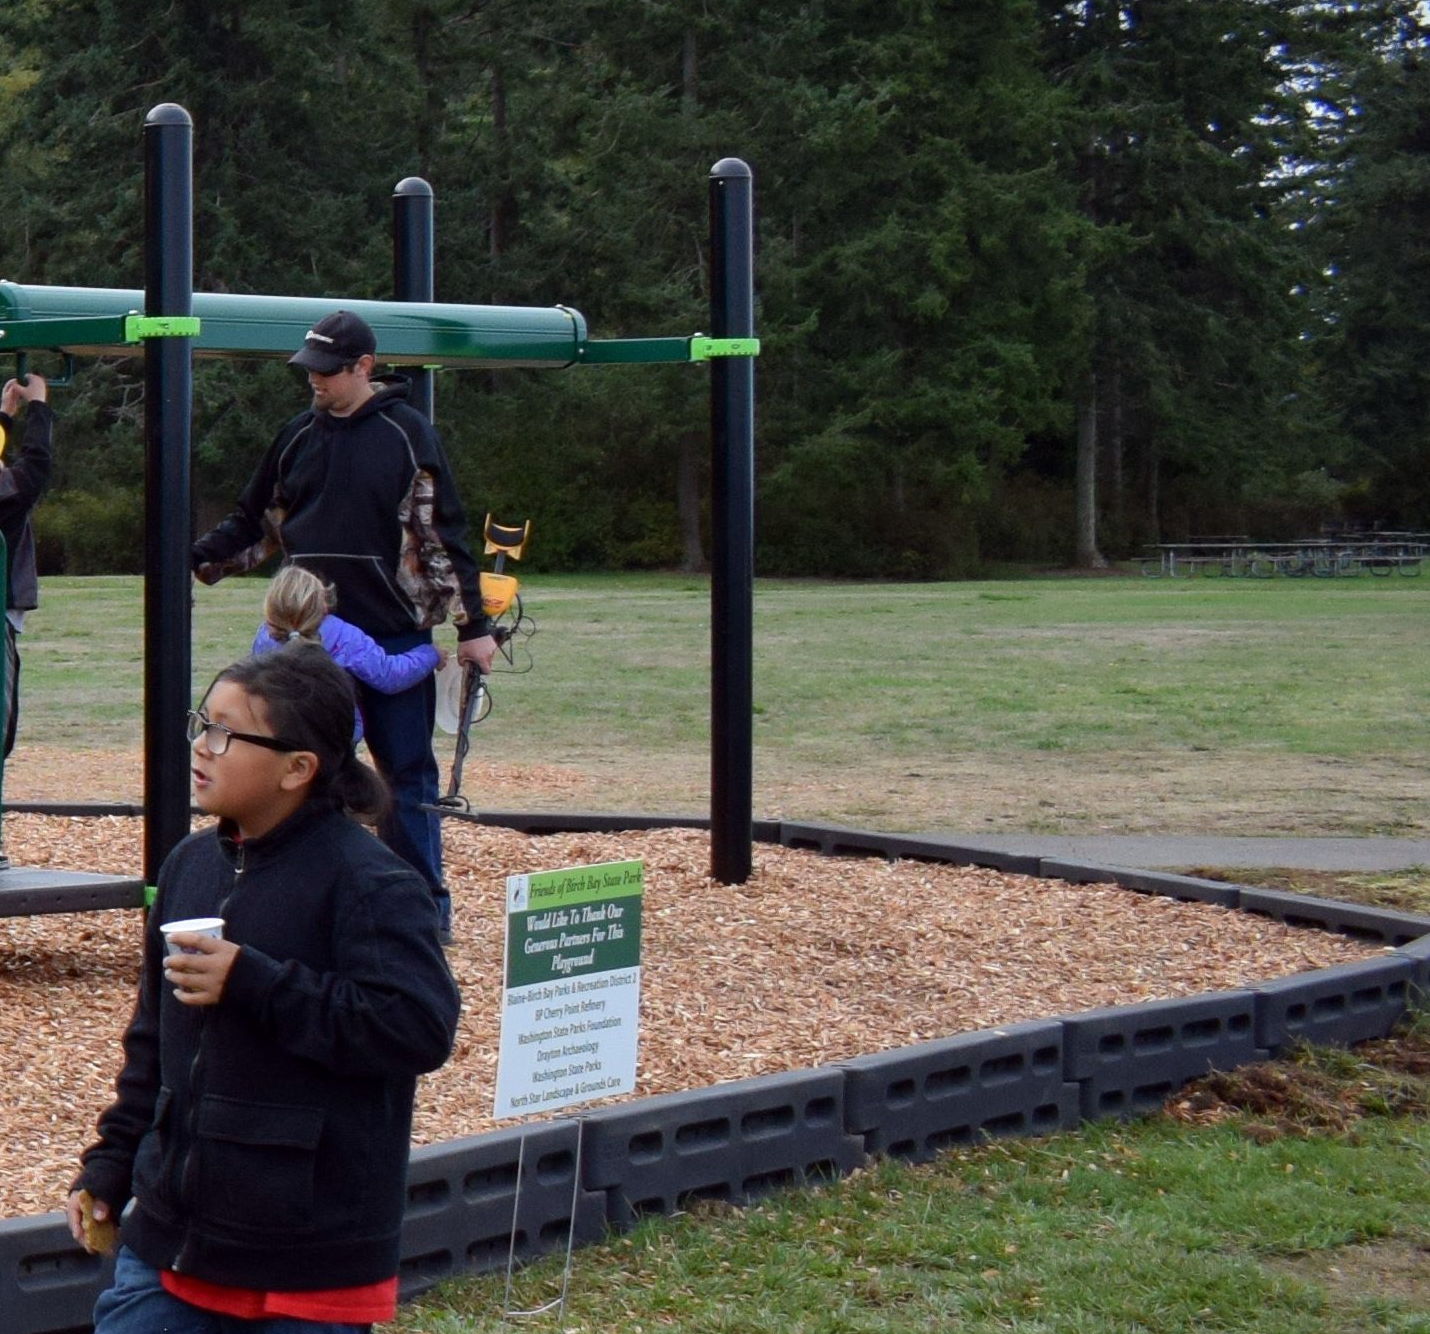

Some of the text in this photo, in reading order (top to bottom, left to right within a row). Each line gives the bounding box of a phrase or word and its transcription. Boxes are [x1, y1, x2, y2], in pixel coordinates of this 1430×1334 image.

[530, 868, 642, 899] Friends of Birch Bay State Park
[526, 903, 624, 932] Would Like To Thank Our
[524, 924, 624, 954] Generous Partners For This
[551, 948, 594, 974] Playground
[508, 988, 542, 1006] Blaine-Birch
[542, 988, 554, 1002] Bay
[555, 984, 570, 996] Parks
[571, 982, 576, 994] &
[577, 979, 608, 992] Recreation
[610, 974, 631, 986] District
[544, 1008, 563, 1020] Cherry
[565, 1003, 580, 1015] Point
[581, 999, 605, 1012] Refinery
[518, 1017, 622, 1044] Washington State Parks Foundation
[537, 1041, 599, 1062] Drayton Archaeology
[532, 1060, 601, 1082] Washington State Parks
[511, 1076, 621, 1107] North Star Landscape & Grounds Care
